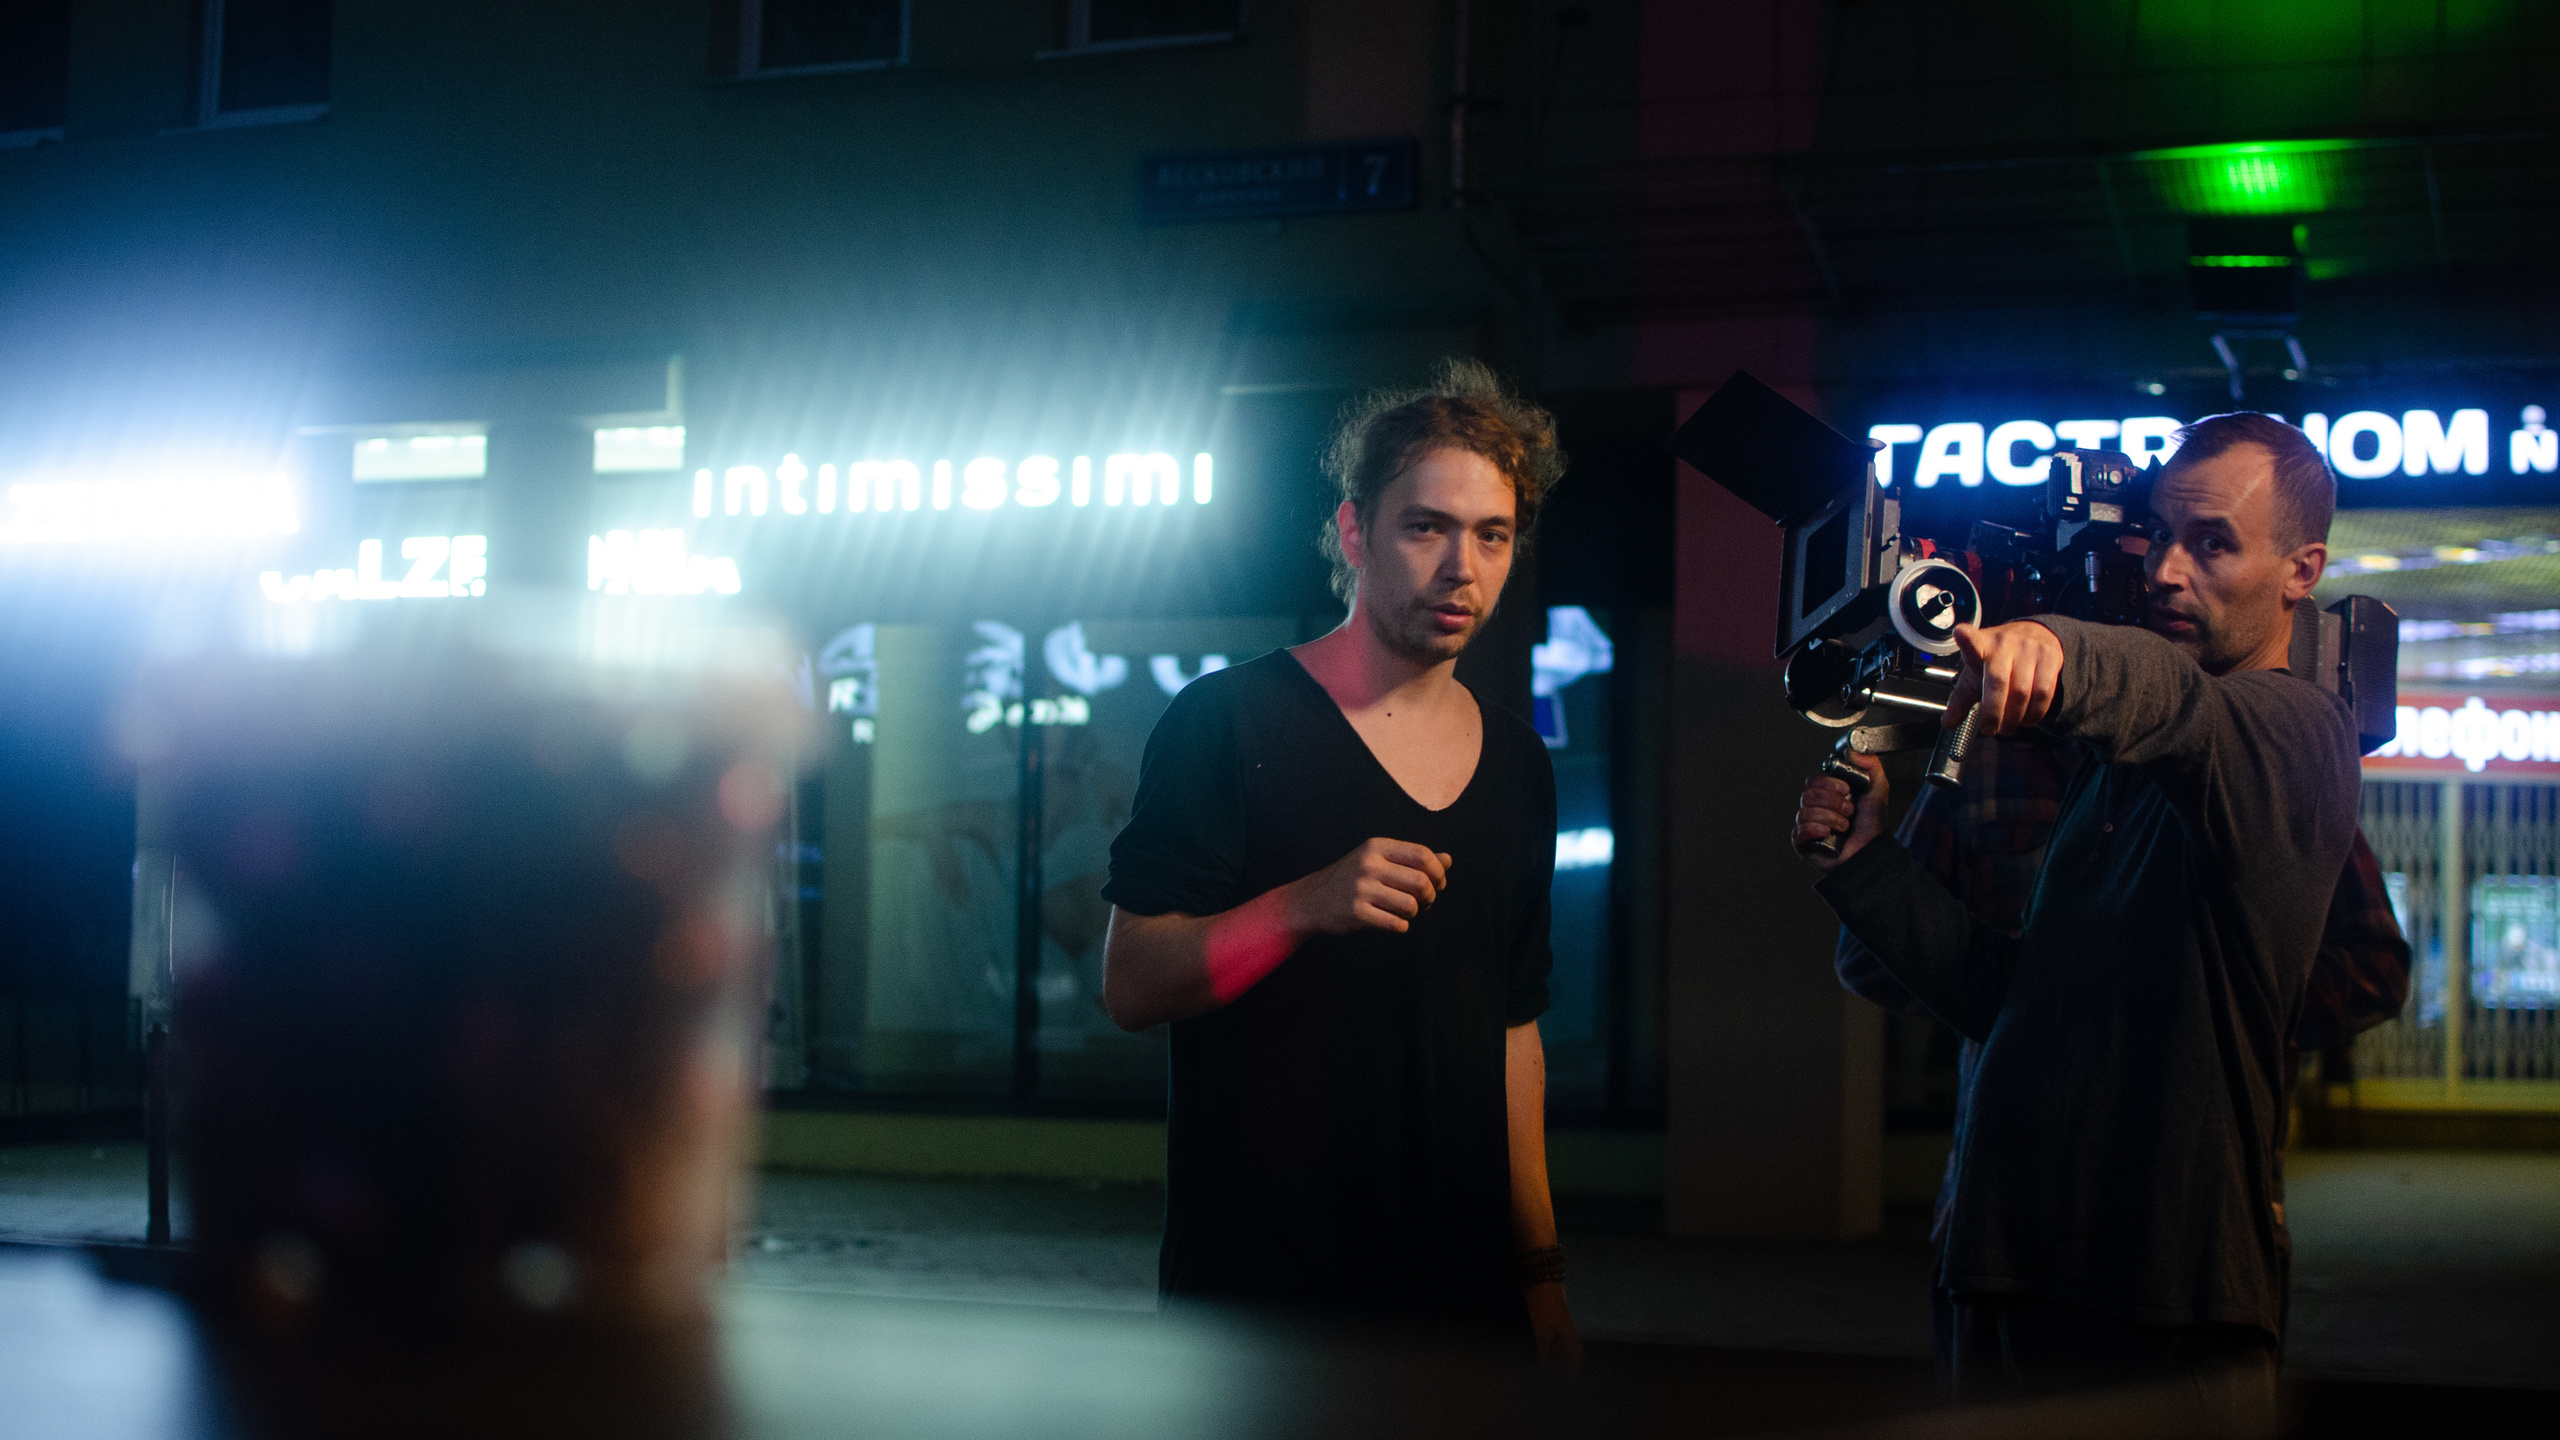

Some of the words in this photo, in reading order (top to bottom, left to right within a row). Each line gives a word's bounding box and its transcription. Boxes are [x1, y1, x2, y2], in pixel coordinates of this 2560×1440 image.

[1362, 154, 1389, 196] 7
[1869, 408, 2489, 488] ГАСТРОМ
[694, 452, 1213, 518] intimissimi
[2369, 696, 2560, 773] лефон
